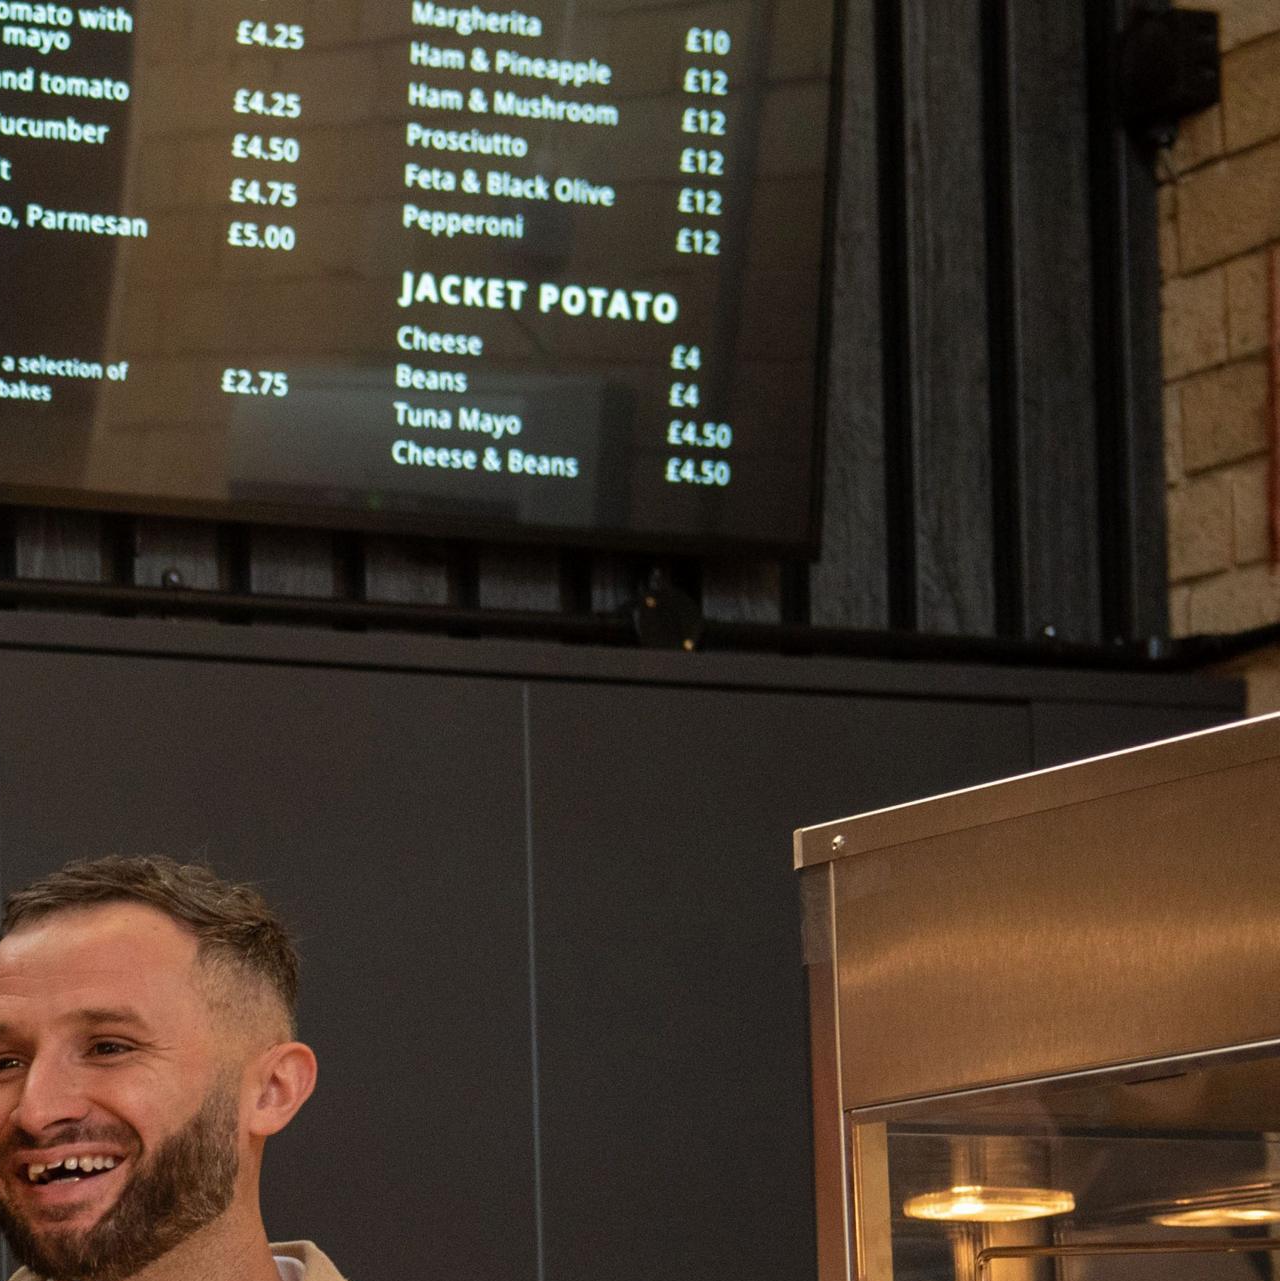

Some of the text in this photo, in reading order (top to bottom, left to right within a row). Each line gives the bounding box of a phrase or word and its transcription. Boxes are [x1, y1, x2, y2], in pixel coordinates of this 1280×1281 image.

[79, 7, 132, 32] with
[412, 1, 541, 36] Margherita
[3, 26, 70, 54] mayo
[237, 21, 304, 49] £4.25
[686, 28, 730, 55] £10
[410, 42, 611, 87] Ham & Pineapple
[40, 72, 129, 101] tomato
[684, 68, 727, 95] £12
[233, 89, 301, 118] £4.25
[409, 83, 618, 125] Ham & Mushroom
[682, 108, 725, 135] £12
[232, 134, 299, 162] £4.50
[407, 123, 527, 157] Prosciutto
[680, 148, 723, 175] £12
[230, 179, 297, 207] £4.75
[405, 164, 614, 206] Feta & Black Olive
[678, 188, 721, 215] £12
[27, 204, 148, 238] Parmesan
[403, 204, 523, 238] Pepperoni
[228, 222, 295, 250] £5.00
[676, 228, 719, 255] £12
[398, 271, 677, 323] JACKET POTATO
[397, 326, 482, 355] Cheese
[2, 356, 14, 371] a
[19, 356, 103, 379] selection
[107, 362, 128, 380] of
[671, 346, 700, 370] £4
[221, 369, 288, 396] £2.75
[396, 364, 467, 392] Beans
[669, 383, 698, 407] £4
[393, 402, 521, 439] Tuna Mayo
[667, 420, 731, 448] £4.50
[392, 440, 578, 477] Cheese & Beans
[666, 458, 730, 485] £4.50
